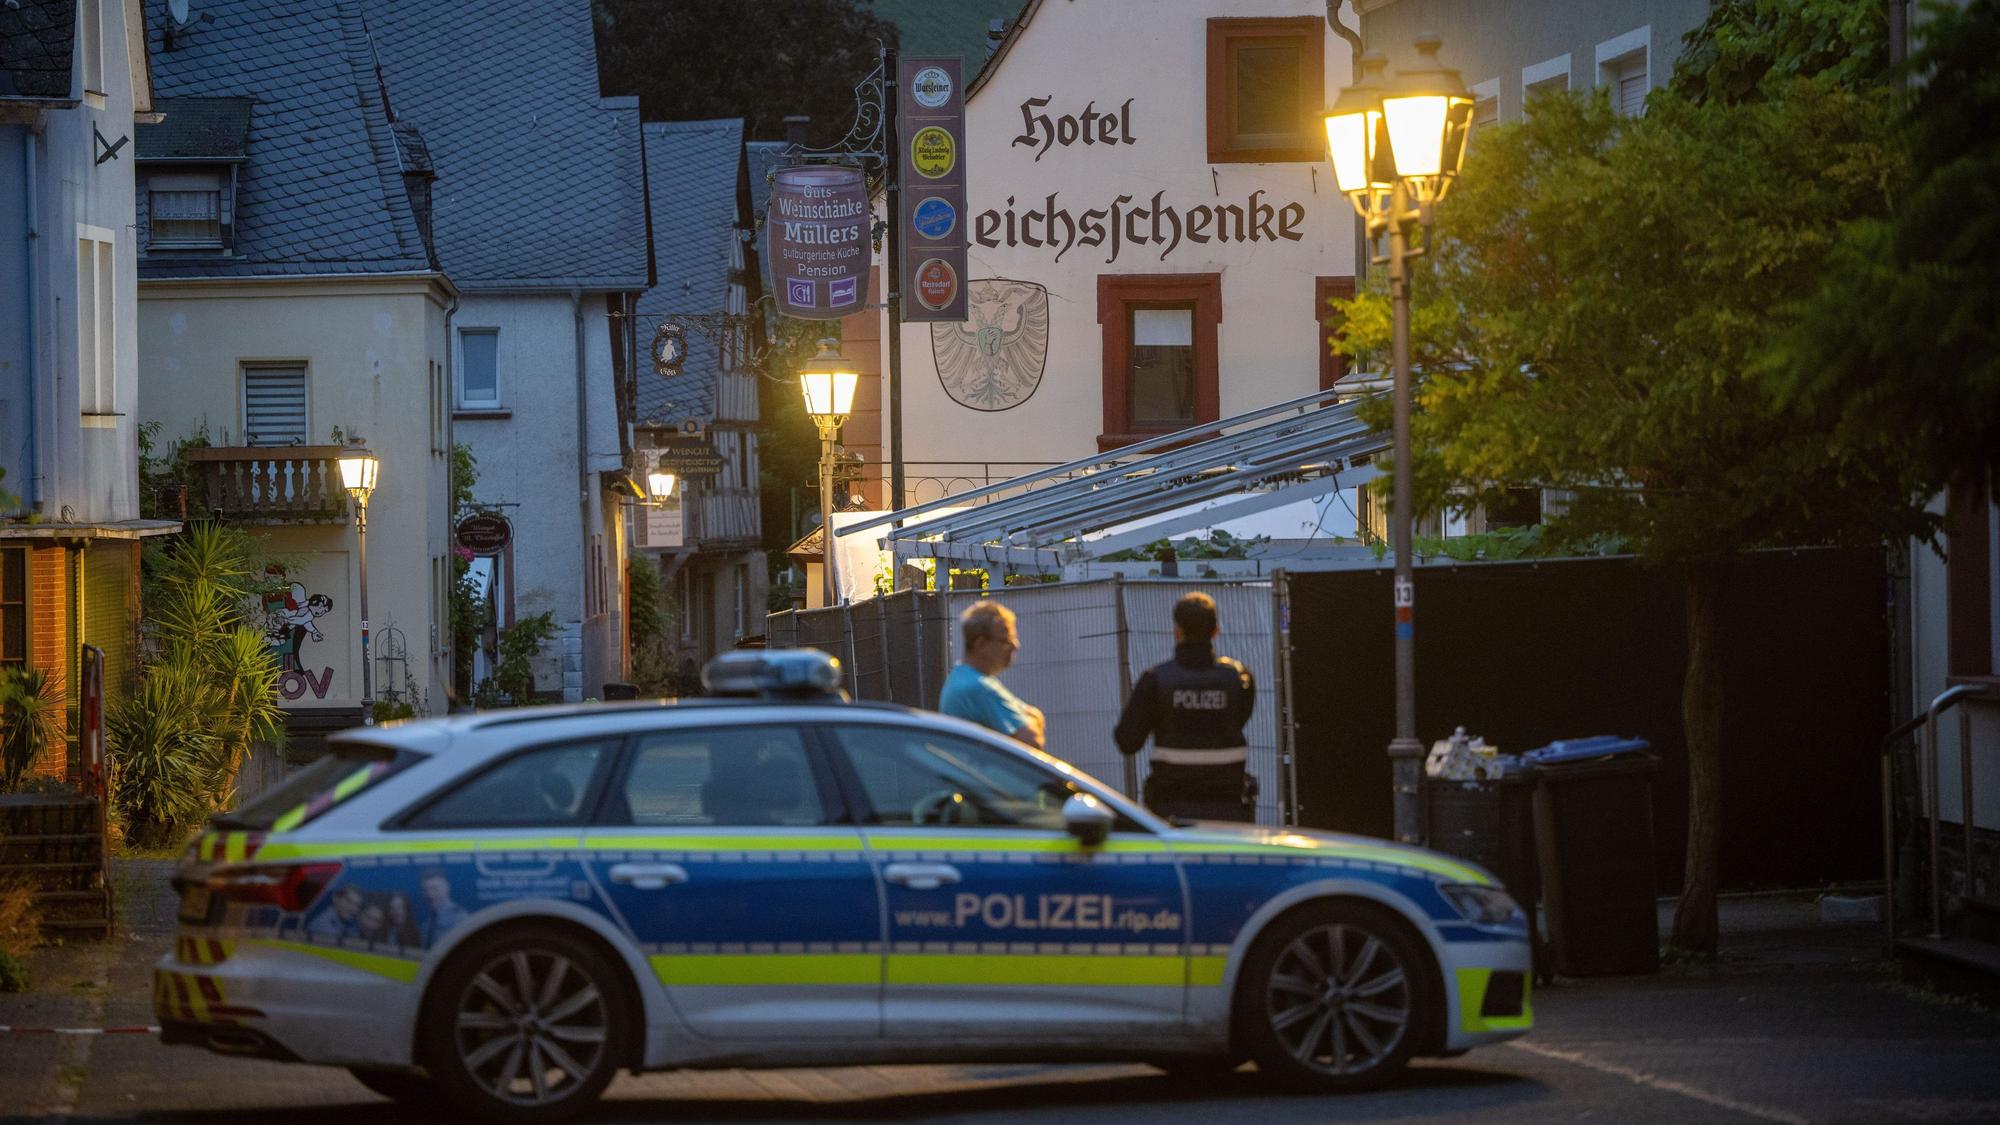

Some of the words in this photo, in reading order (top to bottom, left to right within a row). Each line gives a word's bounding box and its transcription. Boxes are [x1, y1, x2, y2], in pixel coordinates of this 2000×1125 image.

[1011, 94, 1137, 163] Hotel
[803, 184, 837, 199] Guts-
[778, 198, 863, 219] Weinschänke
[784, 221, 860, 245] Müllers
[783, 247, 836, 264] gutbürgerliche
[837, 246, 860, 258] Küche
[798, 263, 847, 277] Pension
[671, 447, 710, 456] WEINGUT
[1396, 587, 1411, 602] 13
[1172, 689, 1227, 710] POLIZEI
